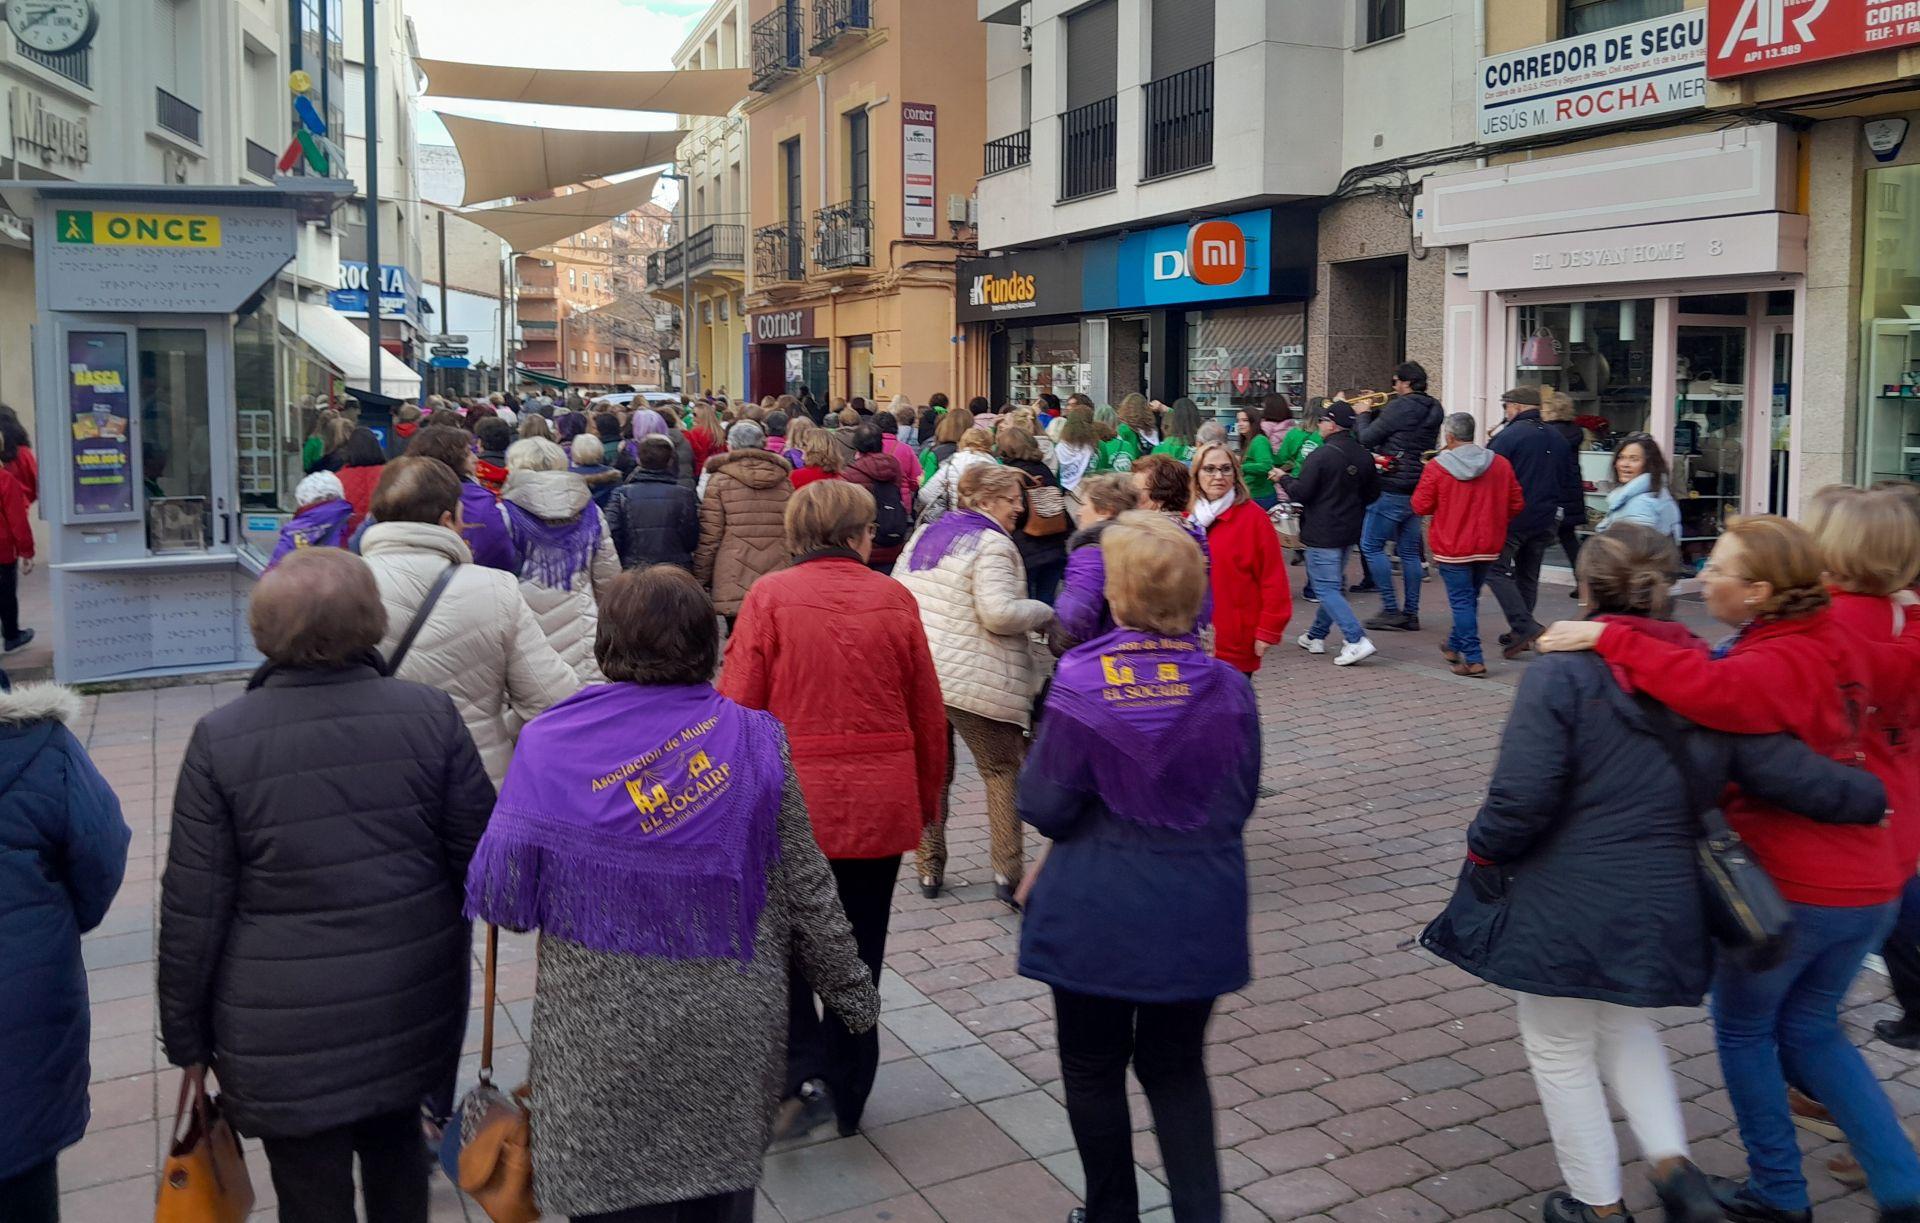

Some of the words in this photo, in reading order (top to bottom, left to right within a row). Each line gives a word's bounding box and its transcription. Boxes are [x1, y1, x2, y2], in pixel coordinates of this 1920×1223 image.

[1866, 1, 1920, 26] CORR
[1485, 43, 1597, 89] CORREDOR
[1605, 35, 1633, 64] DE
[1641, 19, 1704, 56] SEGU
[1483, 108, 1528, 135] JESÚS
[1533, 108, 1549, 126] M.
[1556, 82, 1660, 121] ROCHA
[1668, 77, 1706, 101] MER
[107, 217, 208, 242] ONCE
[1532, 253, 1553, 270] EL
[1560, 248, 1627, 268] DESVAN
[1633, 241, 1686, 263] HOME
[1709, 240, 1724, 257] 8
[757, 311, 803, 339] corner
[664, 736, 681, 753] de
